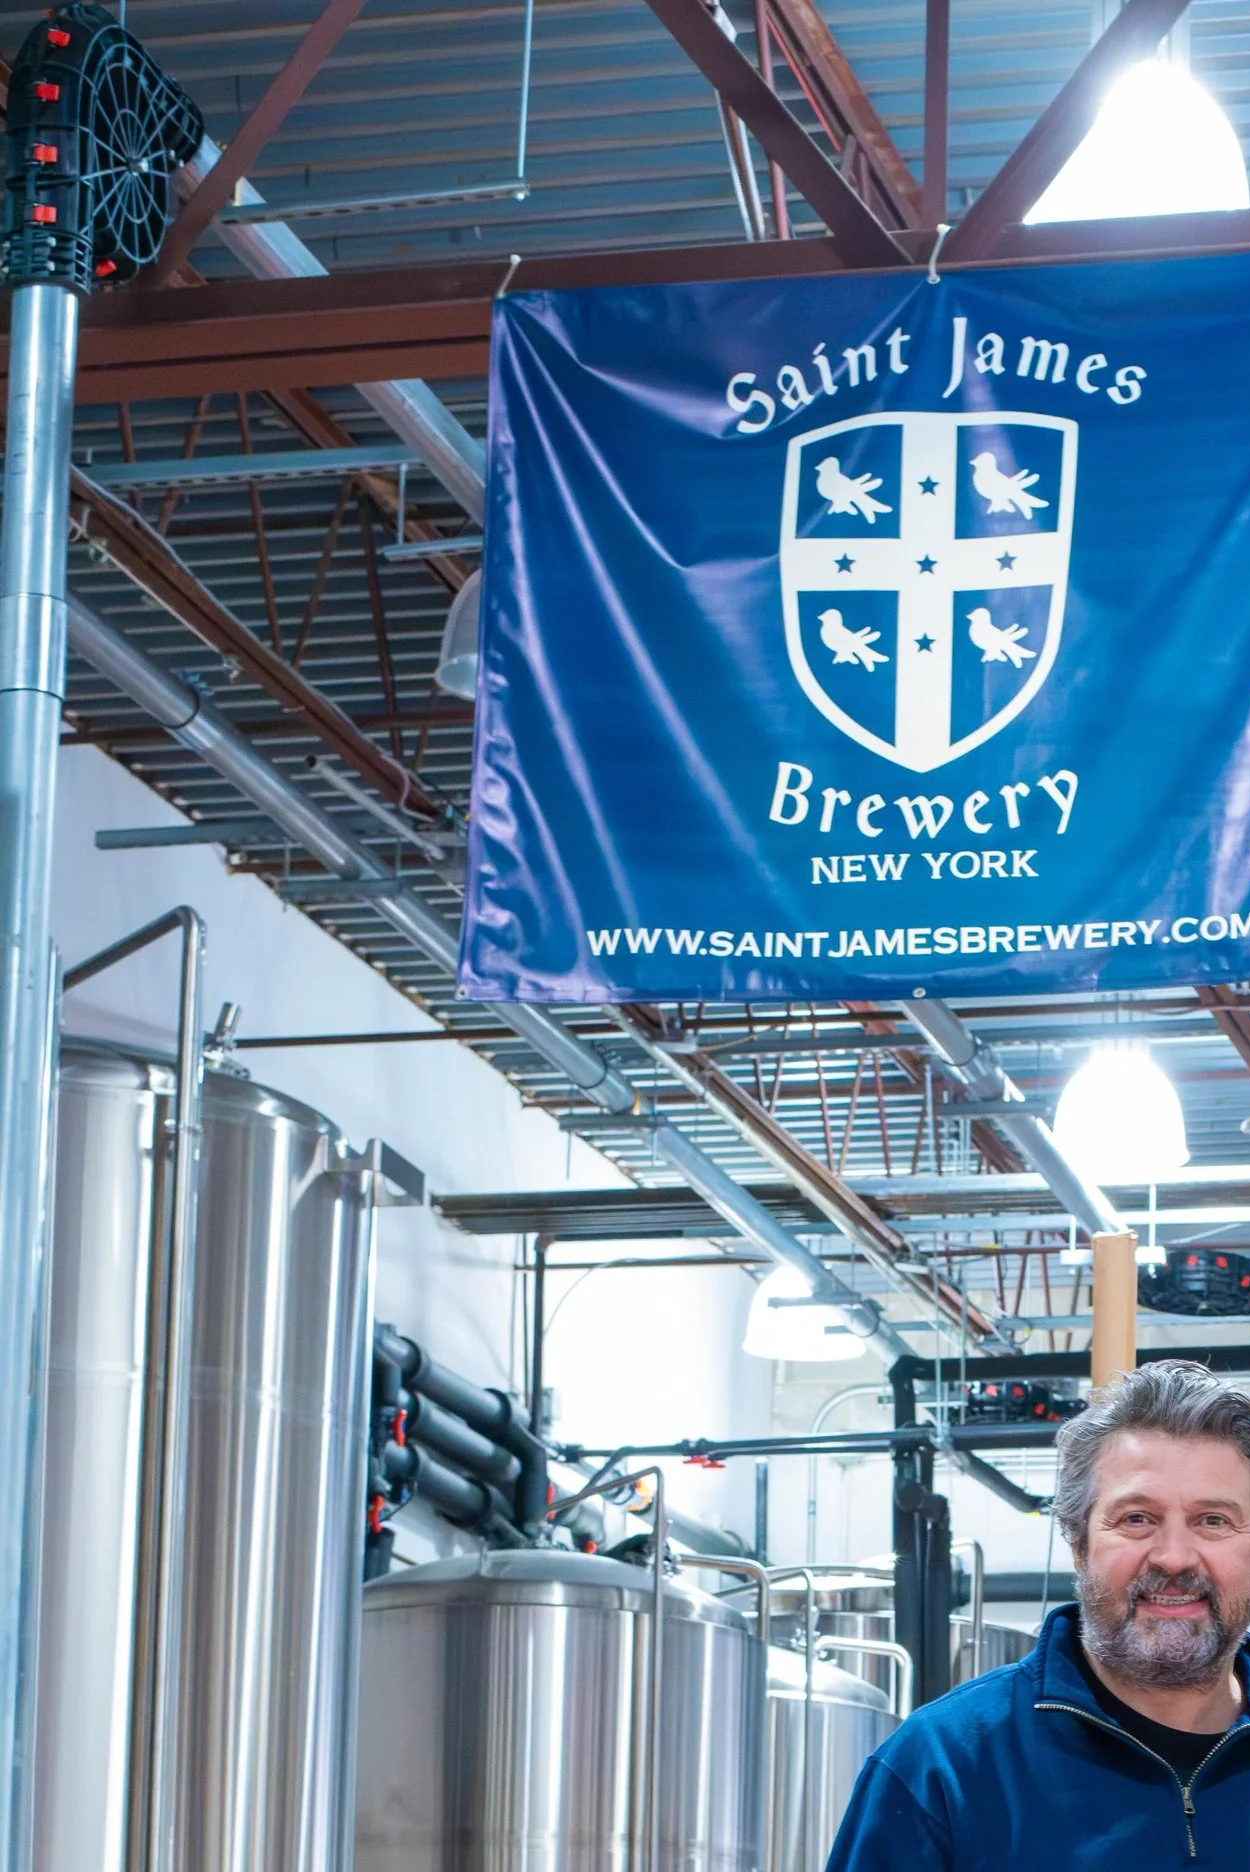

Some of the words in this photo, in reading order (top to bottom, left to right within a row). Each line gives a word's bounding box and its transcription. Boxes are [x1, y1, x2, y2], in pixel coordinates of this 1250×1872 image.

[726, 327, 911, 433] Saint
[942, 317, 1147, 404] James
[769, 761, 1078, 839] Brewery
[810, 853, 910, 884] NEW
[921, 850, 1039, 879] YORK
